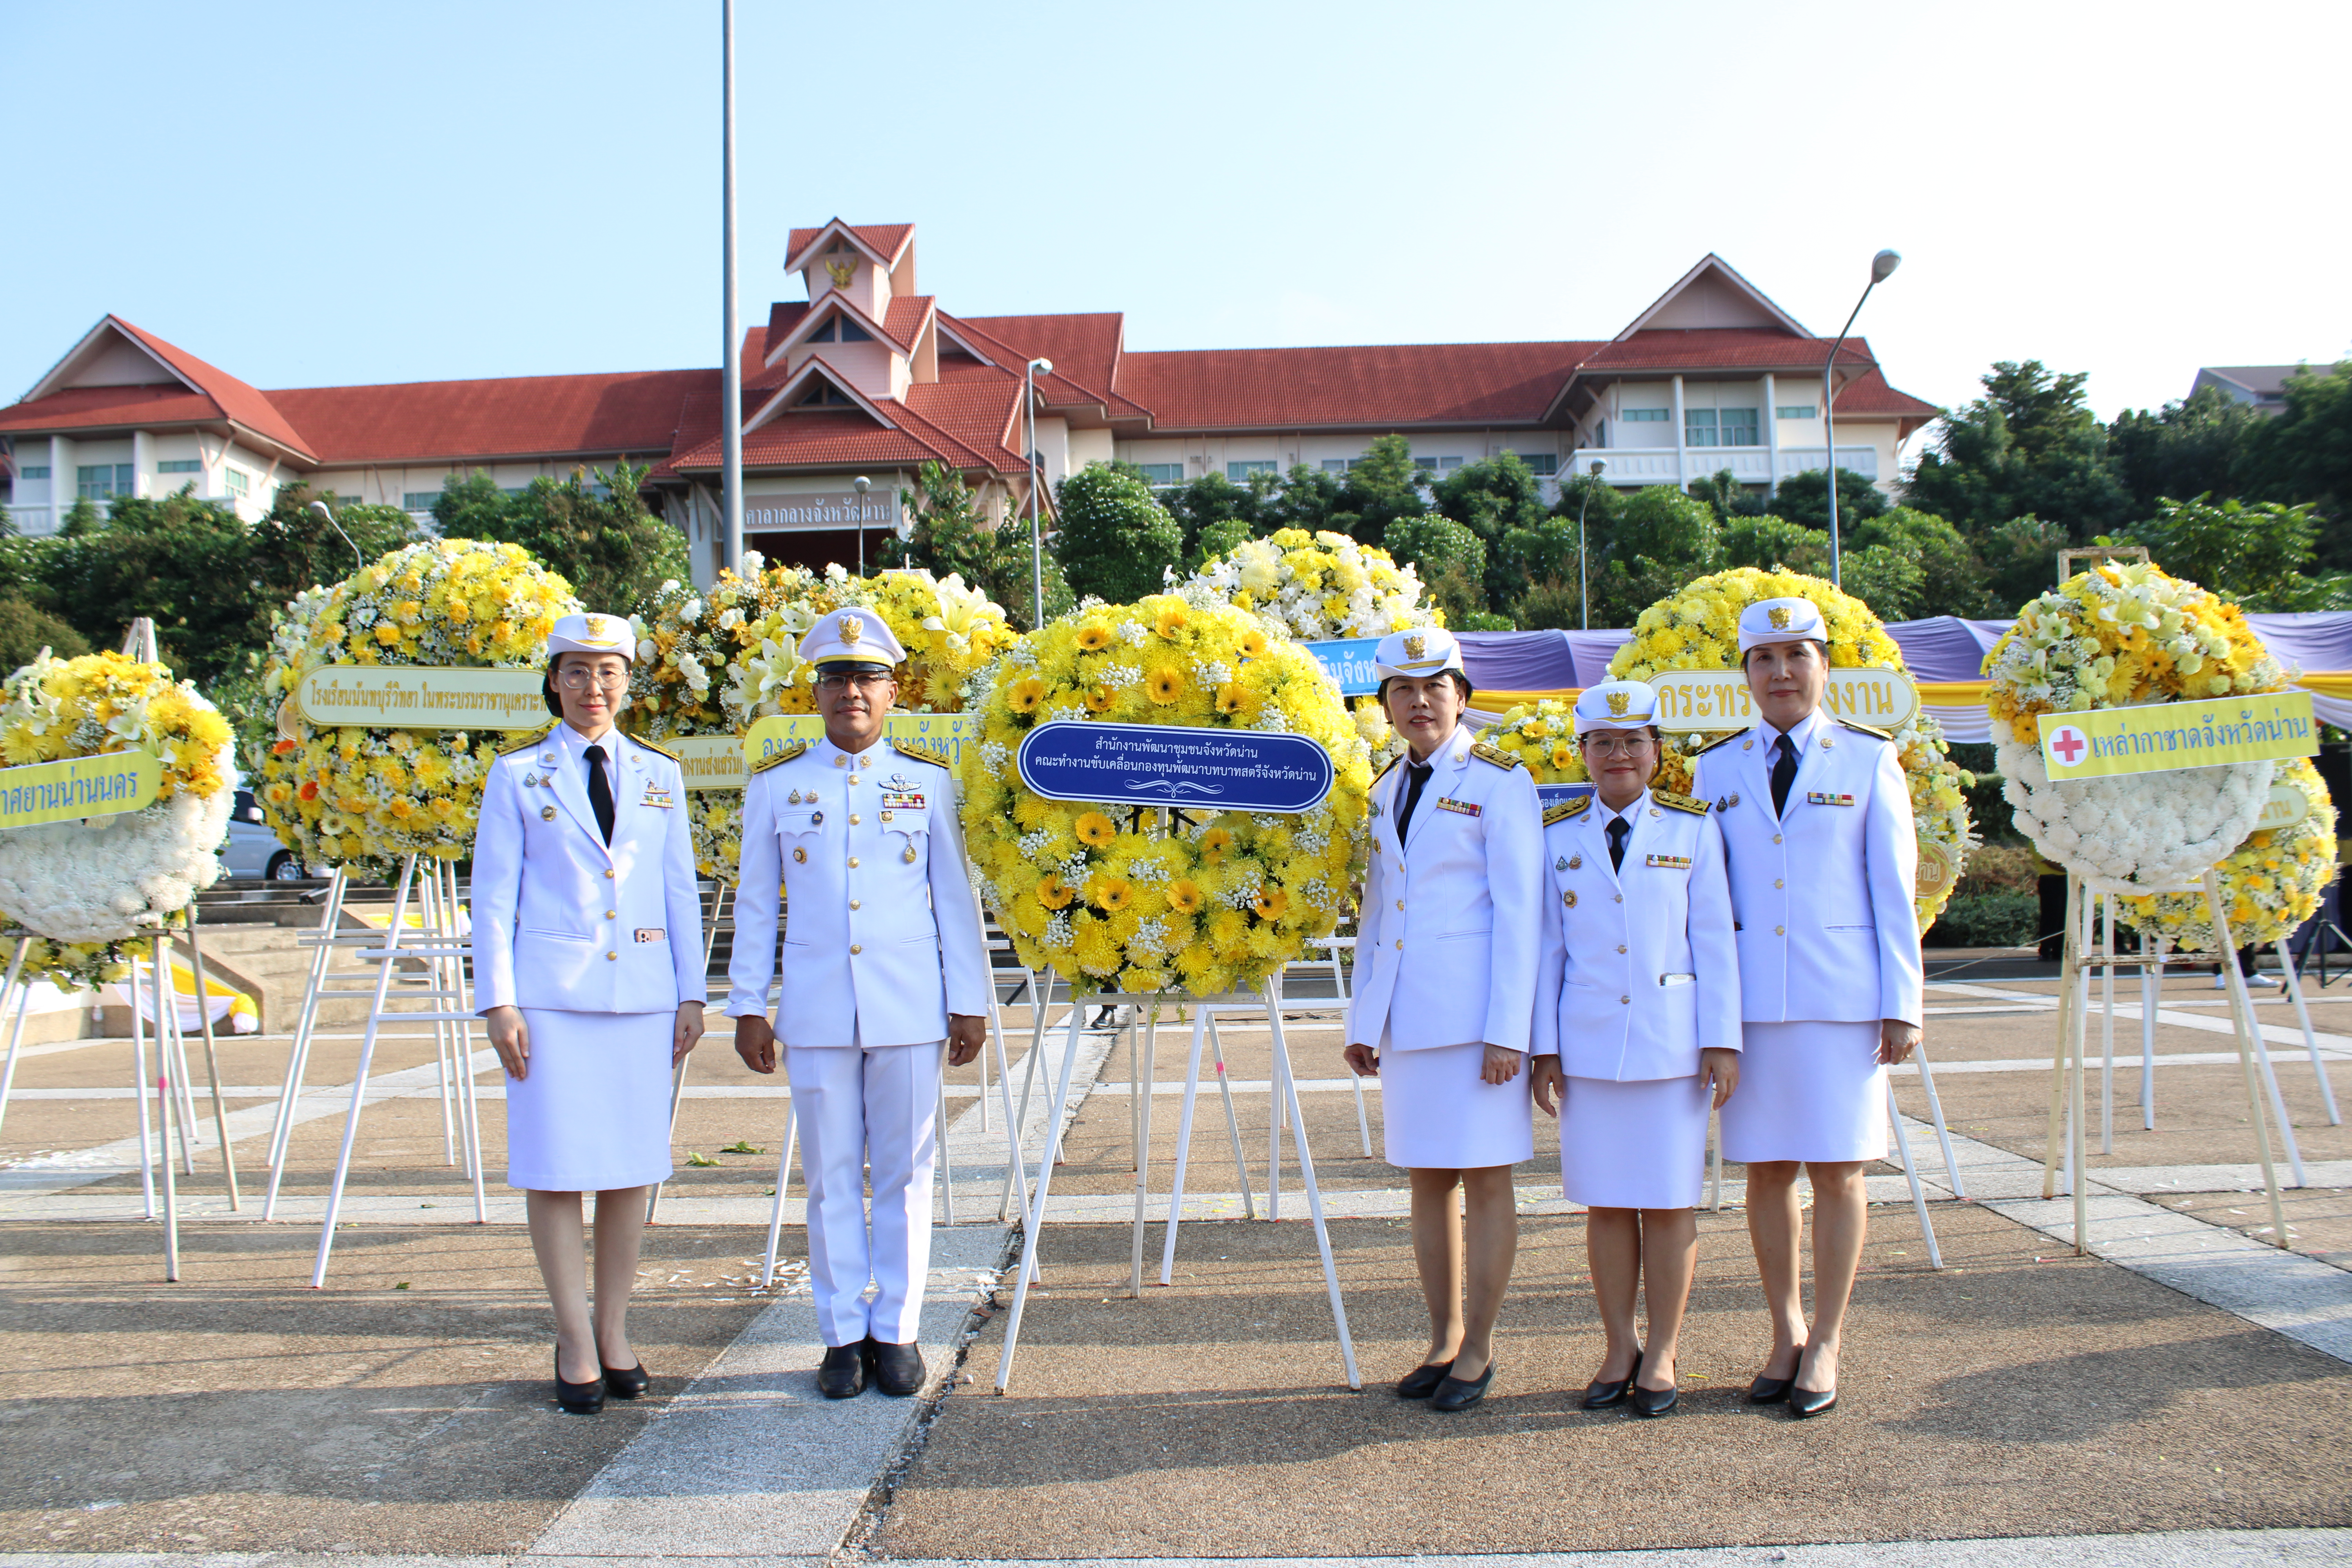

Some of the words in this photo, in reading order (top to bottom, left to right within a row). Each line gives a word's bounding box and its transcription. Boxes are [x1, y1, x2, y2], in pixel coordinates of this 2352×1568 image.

[745, 497, 890, 524] ศาลากลางจังหวัดน่าน
[1318, 651, 1379, 685] ินจังห
[311, 679, 418, 715] โรงเรียนนันทบุรีวิทยา
[422, 681, 547, 718] ในพระบรมราชานุเคราะห
[1659, 681, 1894, 717] กระทรงงาน
[1096, 736, 1258, 759] สำนักงานพัฒนาชุมชนจังหวัดน่าน
[2093, 708, 2309, 757] เหล่ากาชาดจังหวัดน่าน
[1035, 753, 1316, 781] คณะทำงานขับเคลื่อนกองทุนพัฒนาบทบาทสตรีจังหวัดน่าน
